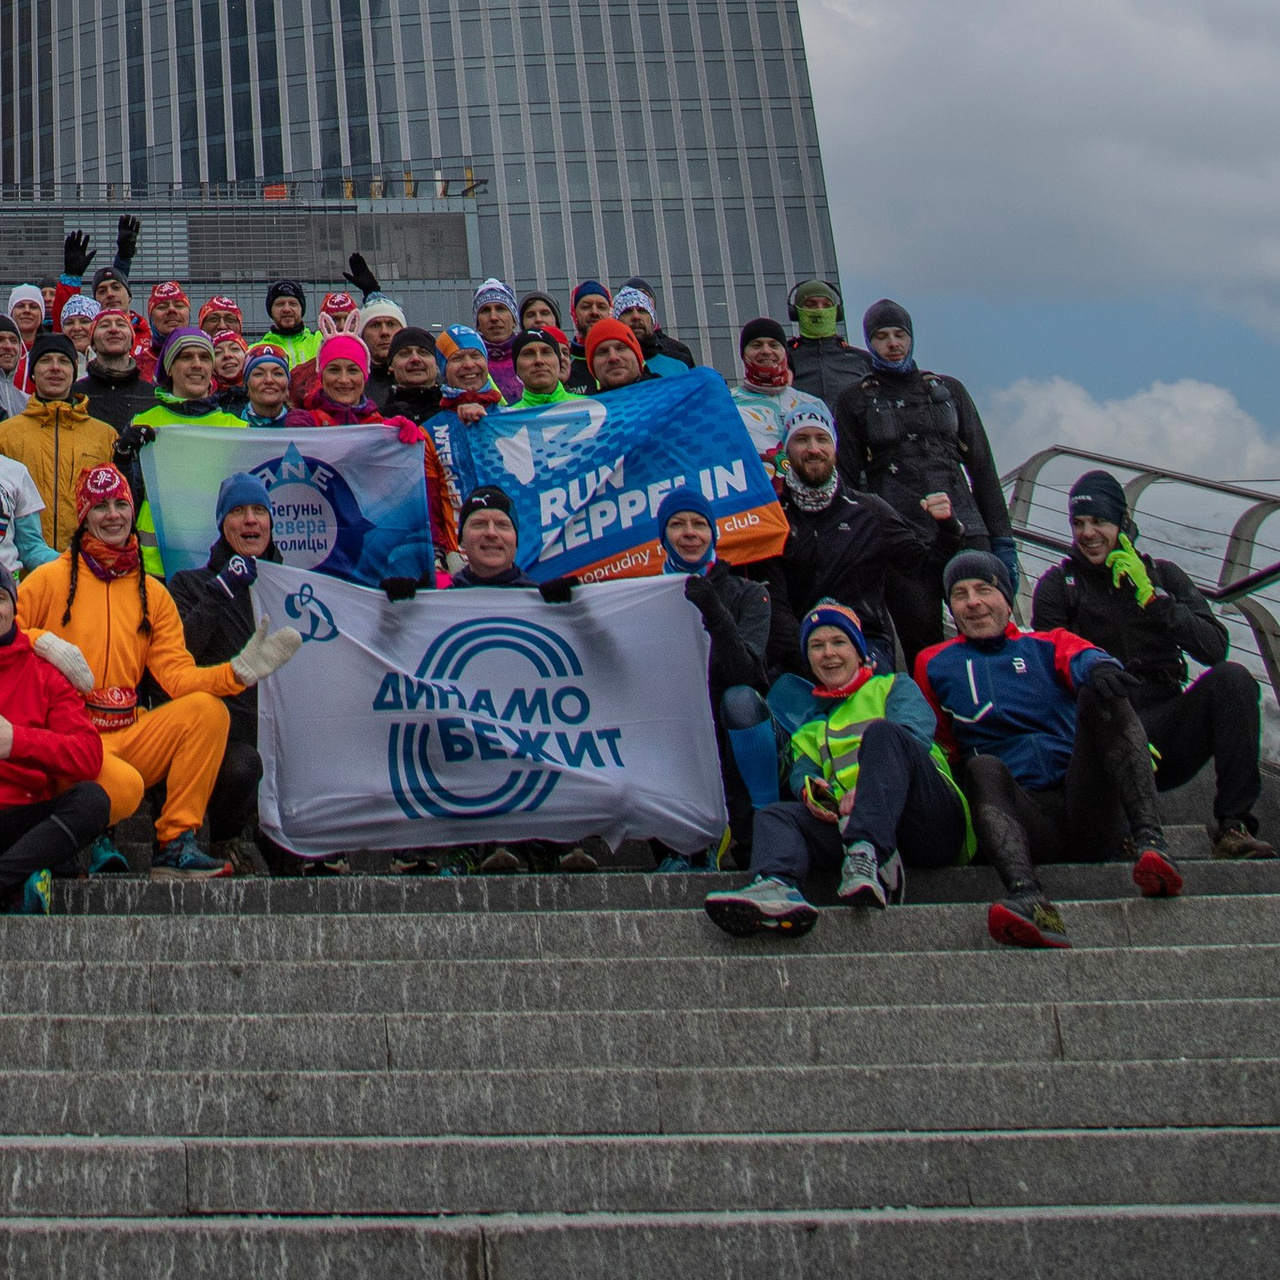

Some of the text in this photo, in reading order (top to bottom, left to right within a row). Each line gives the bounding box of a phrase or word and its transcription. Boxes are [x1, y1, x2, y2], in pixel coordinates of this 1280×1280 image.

[539, 455, 625, 527] RUN
[274, 519, 327, 540] евера
[724, 512, 761, 533] club
[274, 539, 328, 553] толицы
[577, 547, 651, 585] oprudny
[372, 672, 591, 725] ДИНАМО
[437, 716, 626, 768] БЕЖИТ
